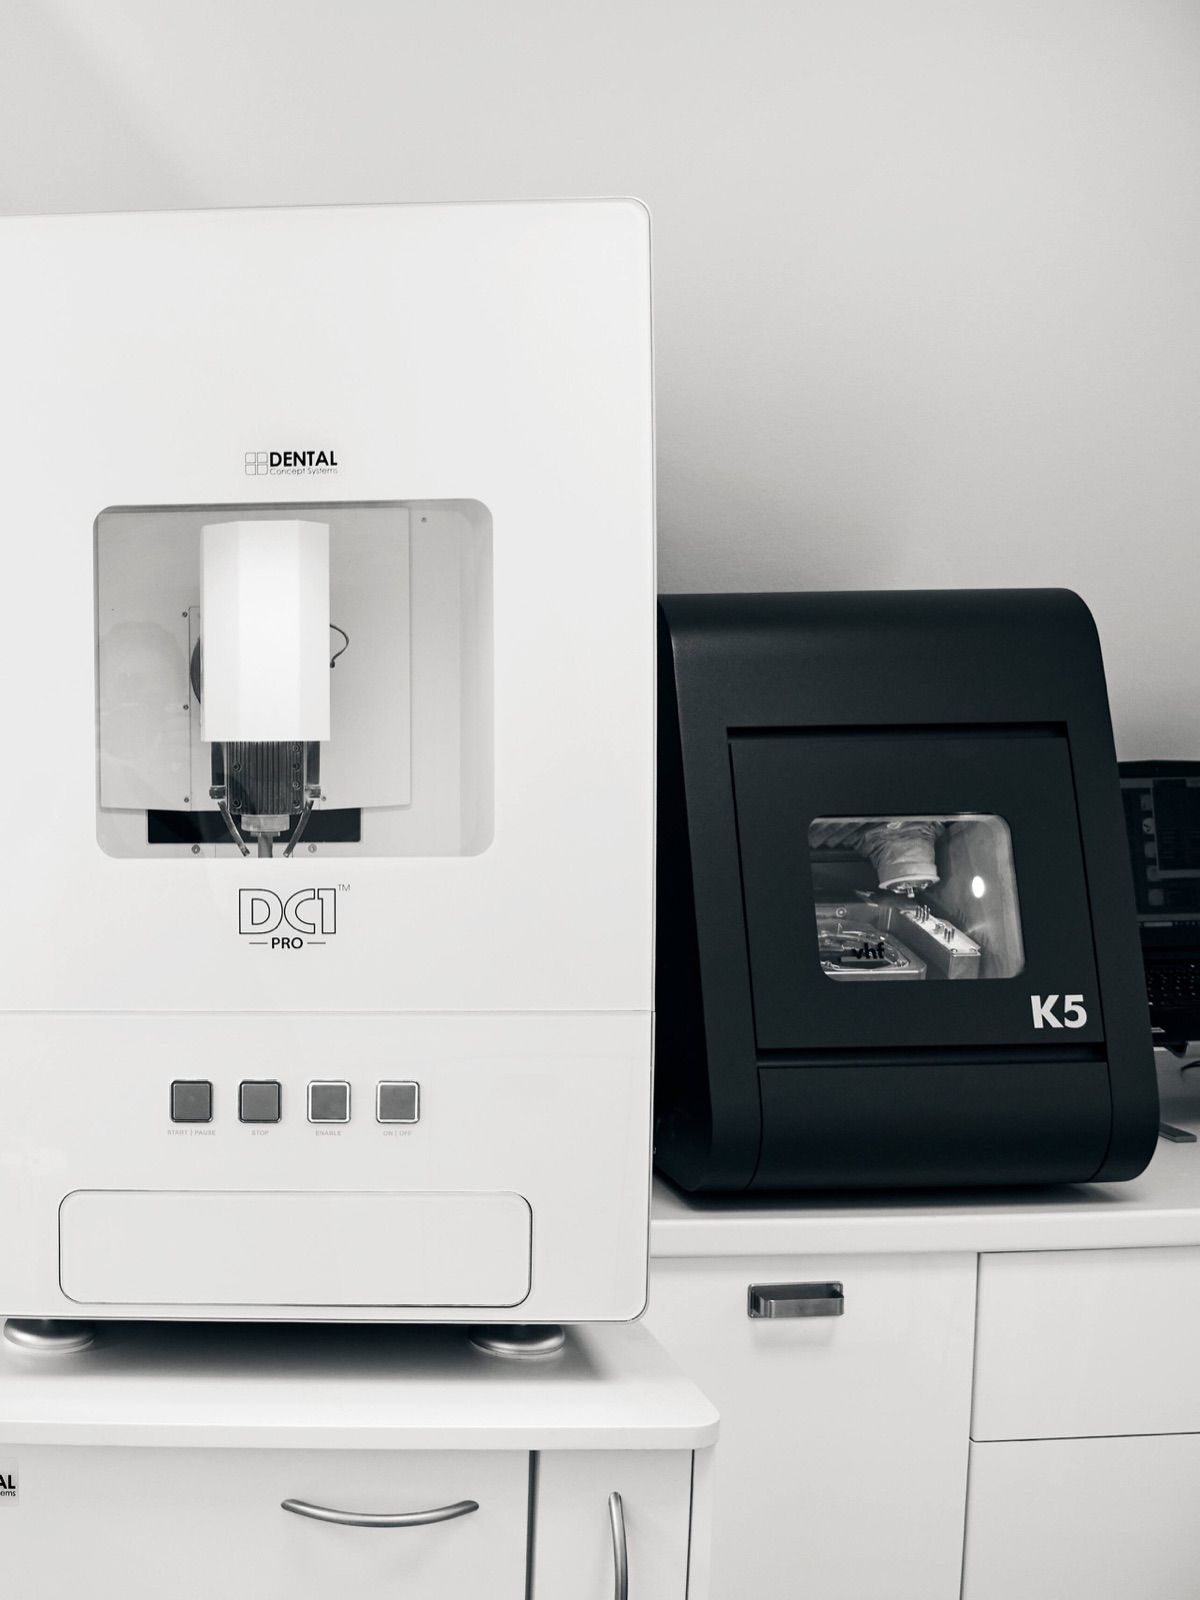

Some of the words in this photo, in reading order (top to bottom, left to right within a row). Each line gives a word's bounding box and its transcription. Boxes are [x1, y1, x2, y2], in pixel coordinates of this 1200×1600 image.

[269, 450, 338, 467] DENTAL
[269, 468, 305, 476] Concept
[307, 467, 338, 476] Systems
[271, 937, 304, 949] PRO
[851, 942, 885, 960] vhf
[1030, 994, 1088, 1029] K5
